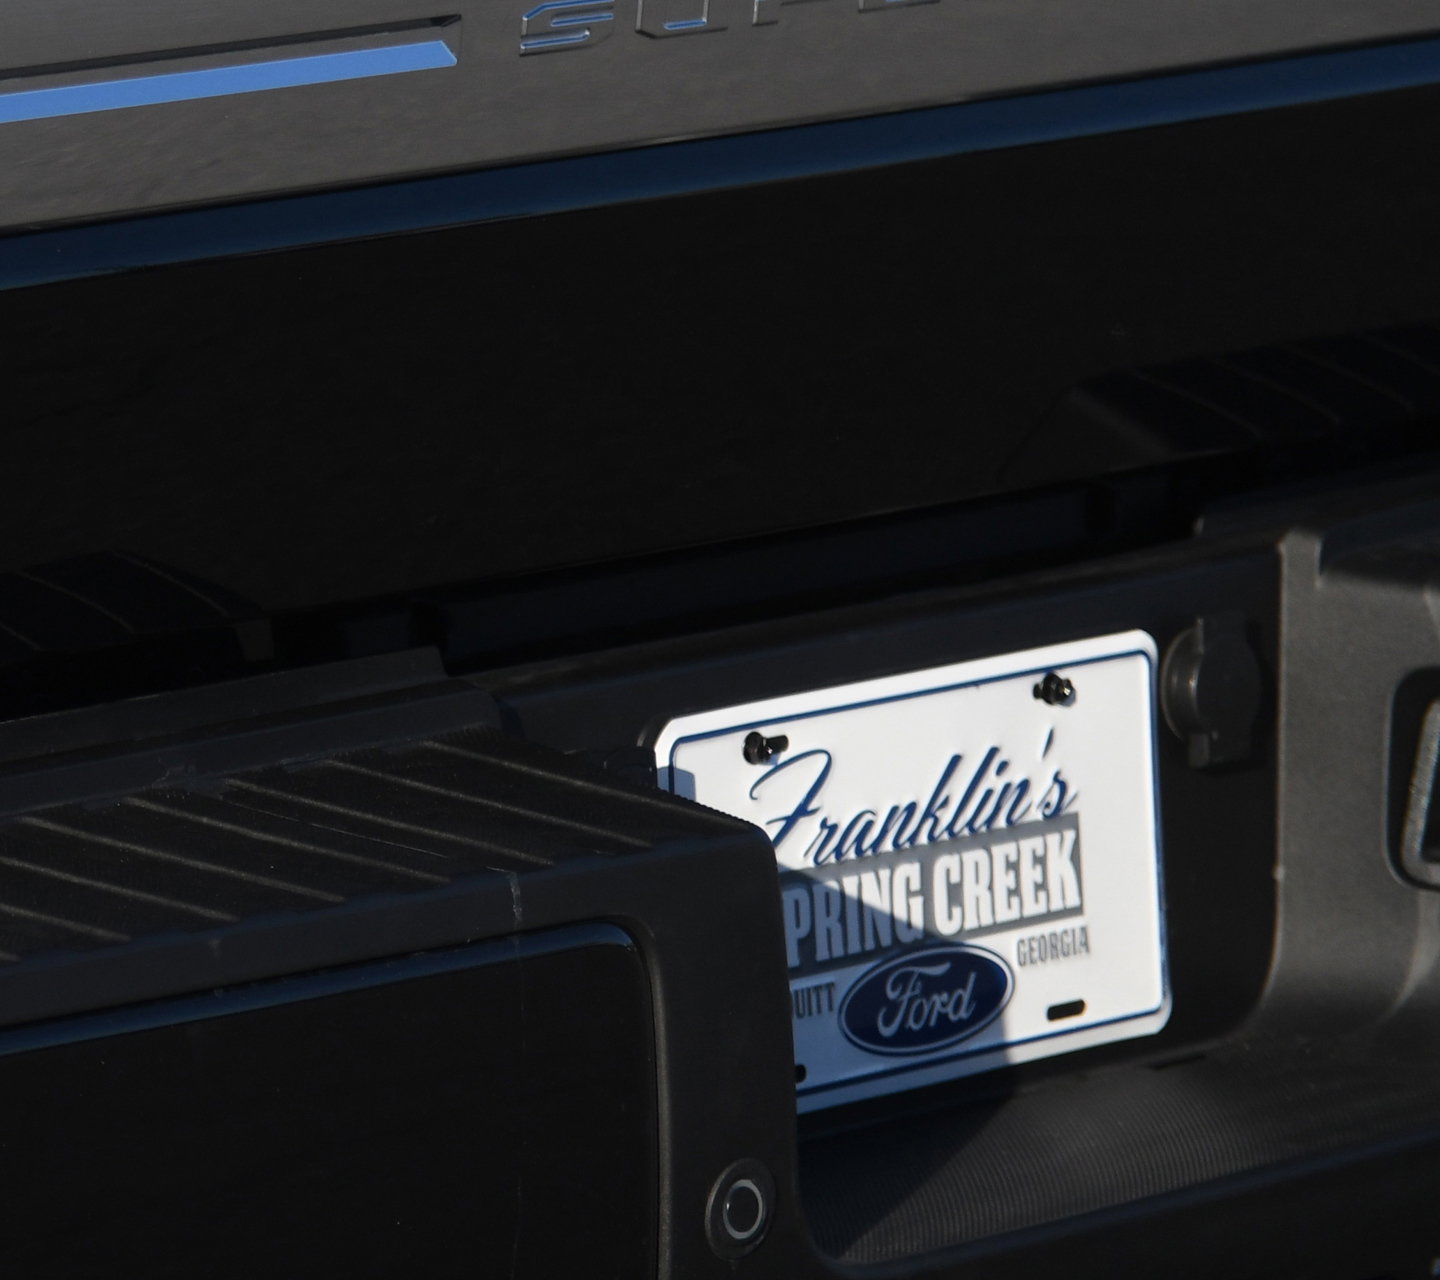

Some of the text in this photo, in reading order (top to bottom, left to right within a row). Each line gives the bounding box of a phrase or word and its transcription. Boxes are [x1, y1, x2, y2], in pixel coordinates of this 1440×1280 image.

[749, 725, 1078, 867] Franklin's
[782, 828, 1081, 969] PRING CREEK
[1016, 924, 1092, 968] GEORGIA
[878, 961, 977, 1039] Ford
